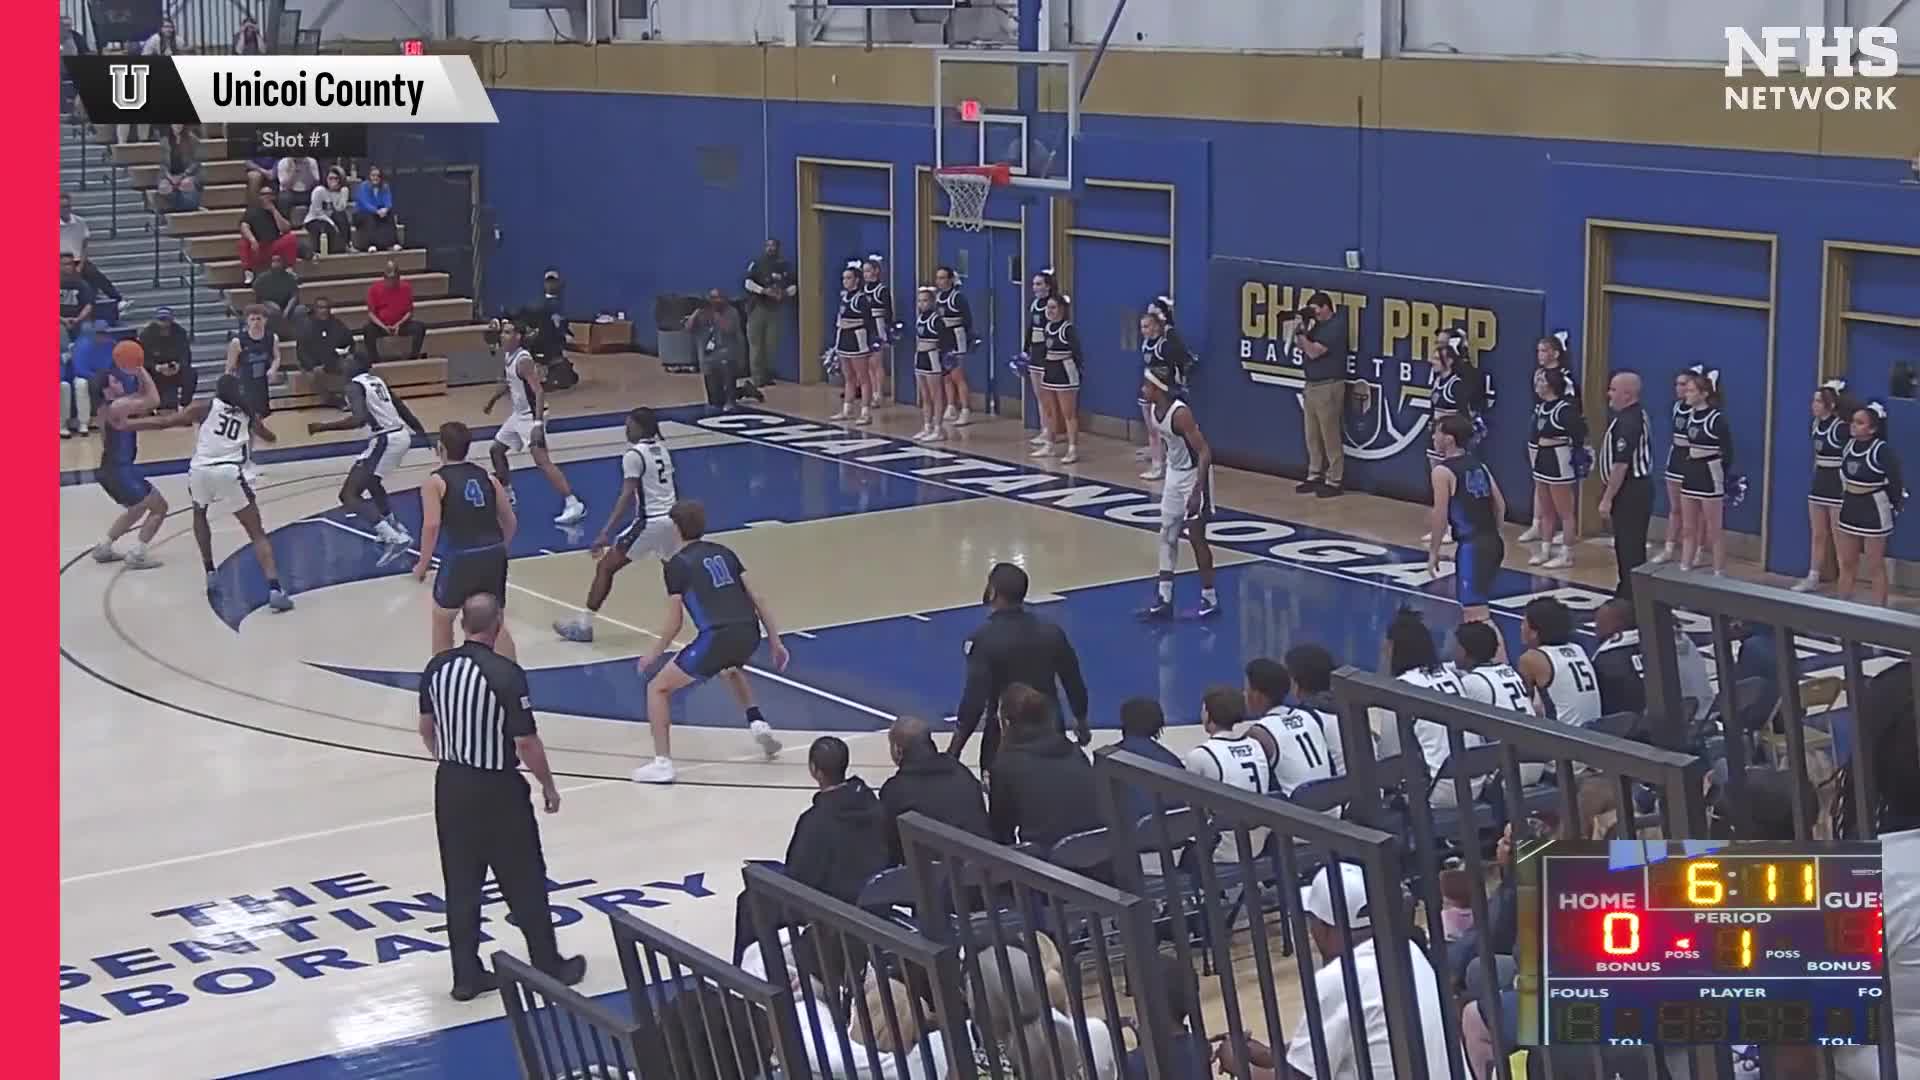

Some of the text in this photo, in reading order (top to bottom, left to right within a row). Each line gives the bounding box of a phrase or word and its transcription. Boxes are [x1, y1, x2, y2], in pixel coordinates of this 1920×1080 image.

[1240, 338, 1496, 396] BASETBL
[214, 413, 242, 441] 30
[655, 459, 668, 484] 2
[464, 479, 485, 507] 4
[697, 414, 1455, 586] CHATTANOOGA
[703, 555, 735, 588] 11
[1568, 661, 1596, 692] 15
[1295, 731, 1323, 768] 11
[151, 871, 391, 929] THE
[1559, 893, 1636, 909] HOME
[1824, 891, 1883, 909] GUE
[1694, 912, 1772, 924] PERIOD
[1603, 912, 1640, 955] 0
[1665, 950, 1700, 959] POSS
[1741, 928, 1752, 968] 1
[1766, 950, 1800, 959] POSS
[1596, 962, 1661, 972] BONUS
[1807, 961, 1872, 971] BONUS
[1550, 988, 1609, 998] FOULS
[1700, 988, 1766, 998] PLAYER
